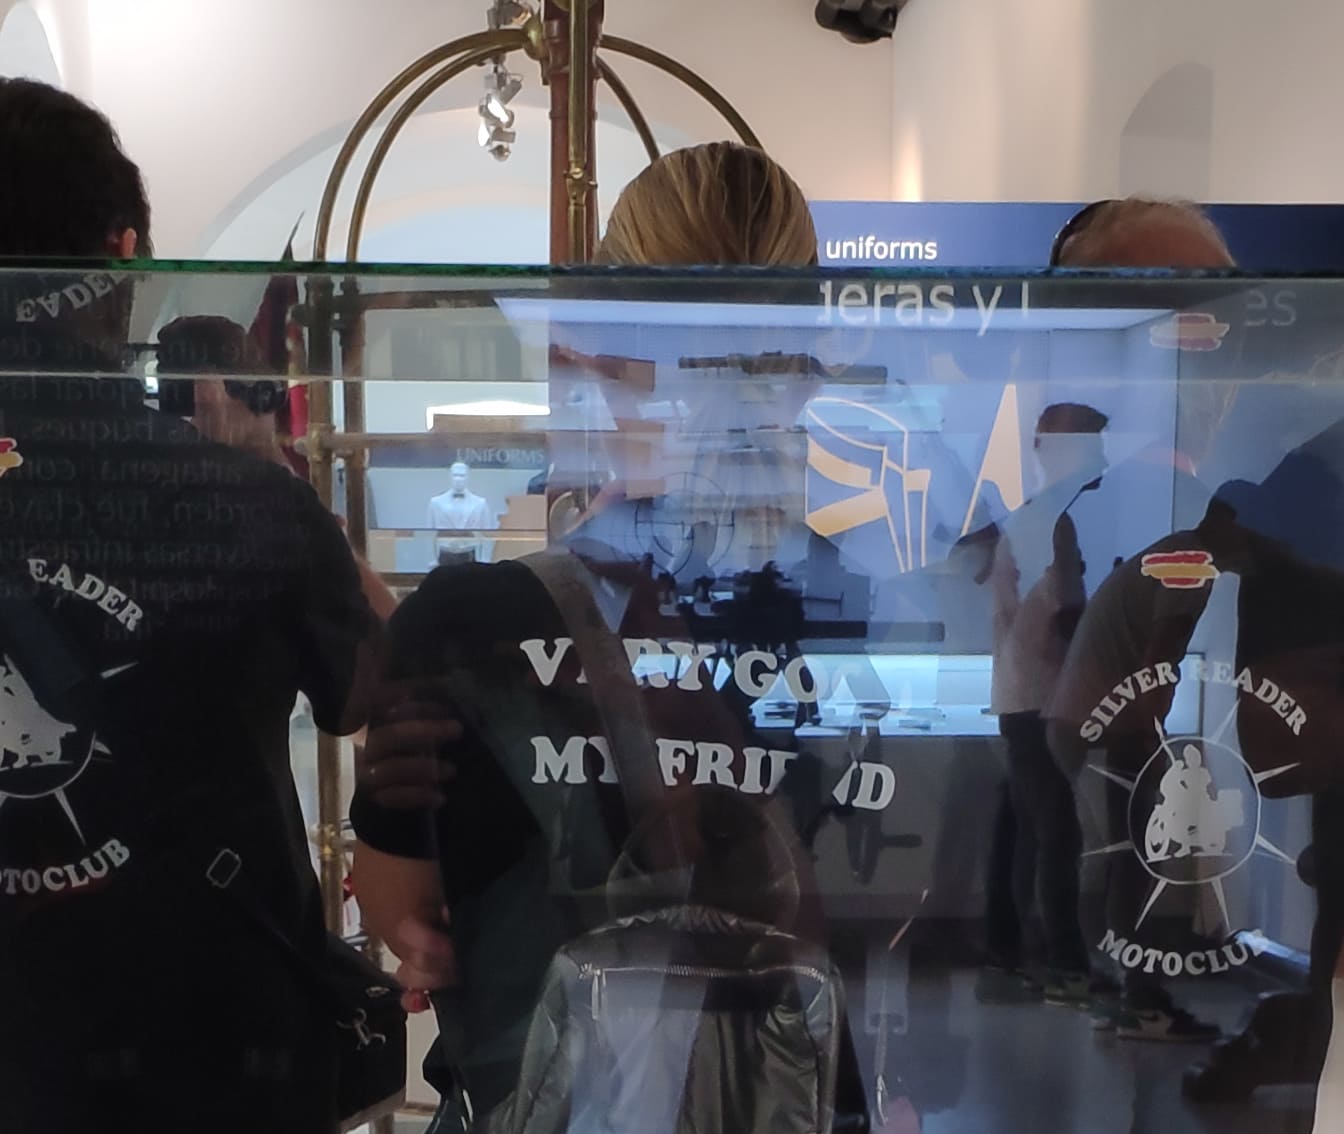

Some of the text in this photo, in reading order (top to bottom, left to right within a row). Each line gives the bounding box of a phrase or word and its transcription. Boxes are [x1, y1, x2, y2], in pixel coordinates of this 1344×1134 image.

[825, 236, 938, 261] uniforms
[972, 284, 1003, 337] y
[456, 446, 546, 464] UNIFORMS
[28, 557, 144, 632] EADER
[519, 637, 718, 692] VRY
[1080, 657, 1307, 743] SILVER READER
[655, 737, 897, 811] FRID
